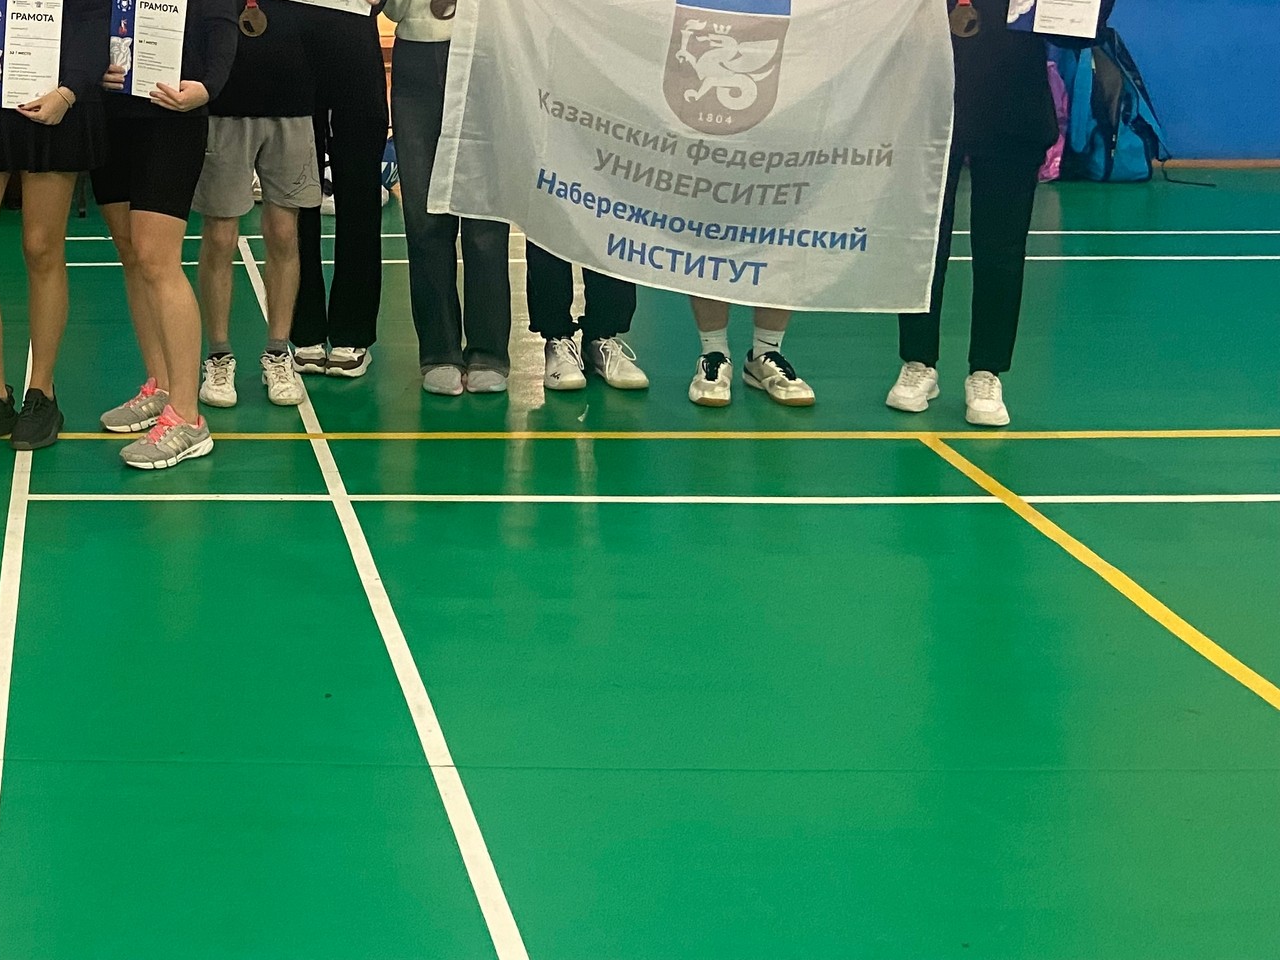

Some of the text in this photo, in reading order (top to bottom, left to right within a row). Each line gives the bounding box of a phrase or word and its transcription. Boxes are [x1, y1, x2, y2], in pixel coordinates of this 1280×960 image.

[10, 12, 55, 23] ГРАМОТА
[139, 1, 179, 14] ГРАМОТА
[537, 88, 894, 174] Казанский федеральный
[697, 111, 732, 125] 1804
[592, 147, 811, 207] УНИВЕРСИТЕТ
[535, 167, 869, 252] Набережночелнинский
[606, 232, 769, 286] ИНСТИТУТ
